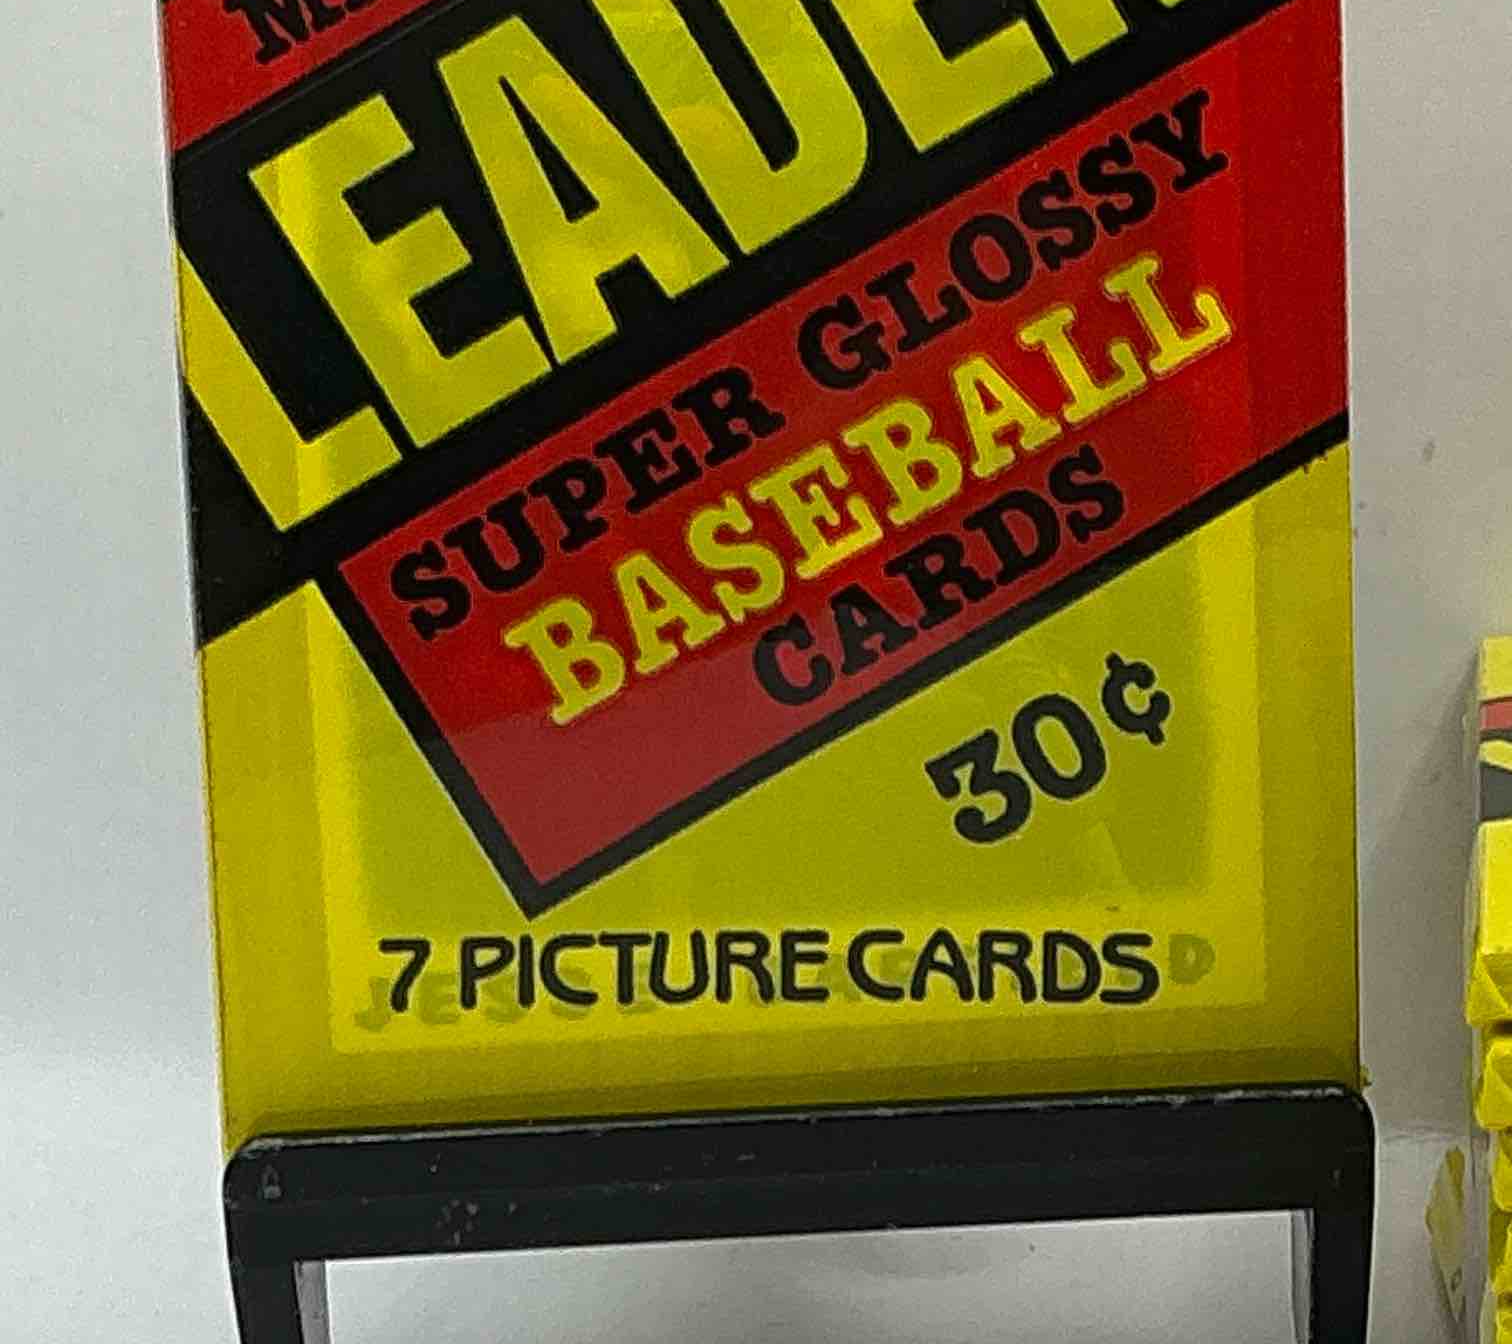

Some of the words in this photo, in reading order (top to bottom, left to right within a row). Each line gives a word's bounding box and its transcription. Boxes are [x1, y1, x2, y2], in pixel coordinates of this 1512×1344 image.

[388, 364, 787, 640] SUPER
[798, 90, 1230, 394] GLOSSY
[506, 255, 1234, 728] BASEBALL
[752, 444, 1127, 711] CARDS
[924, 652, 1174, 847] 30¢
[378, 936, 430, 1013] 7
[458, 928, 831, 1009] PICTURE
[846, 927, 1163, 1006] CARDS
